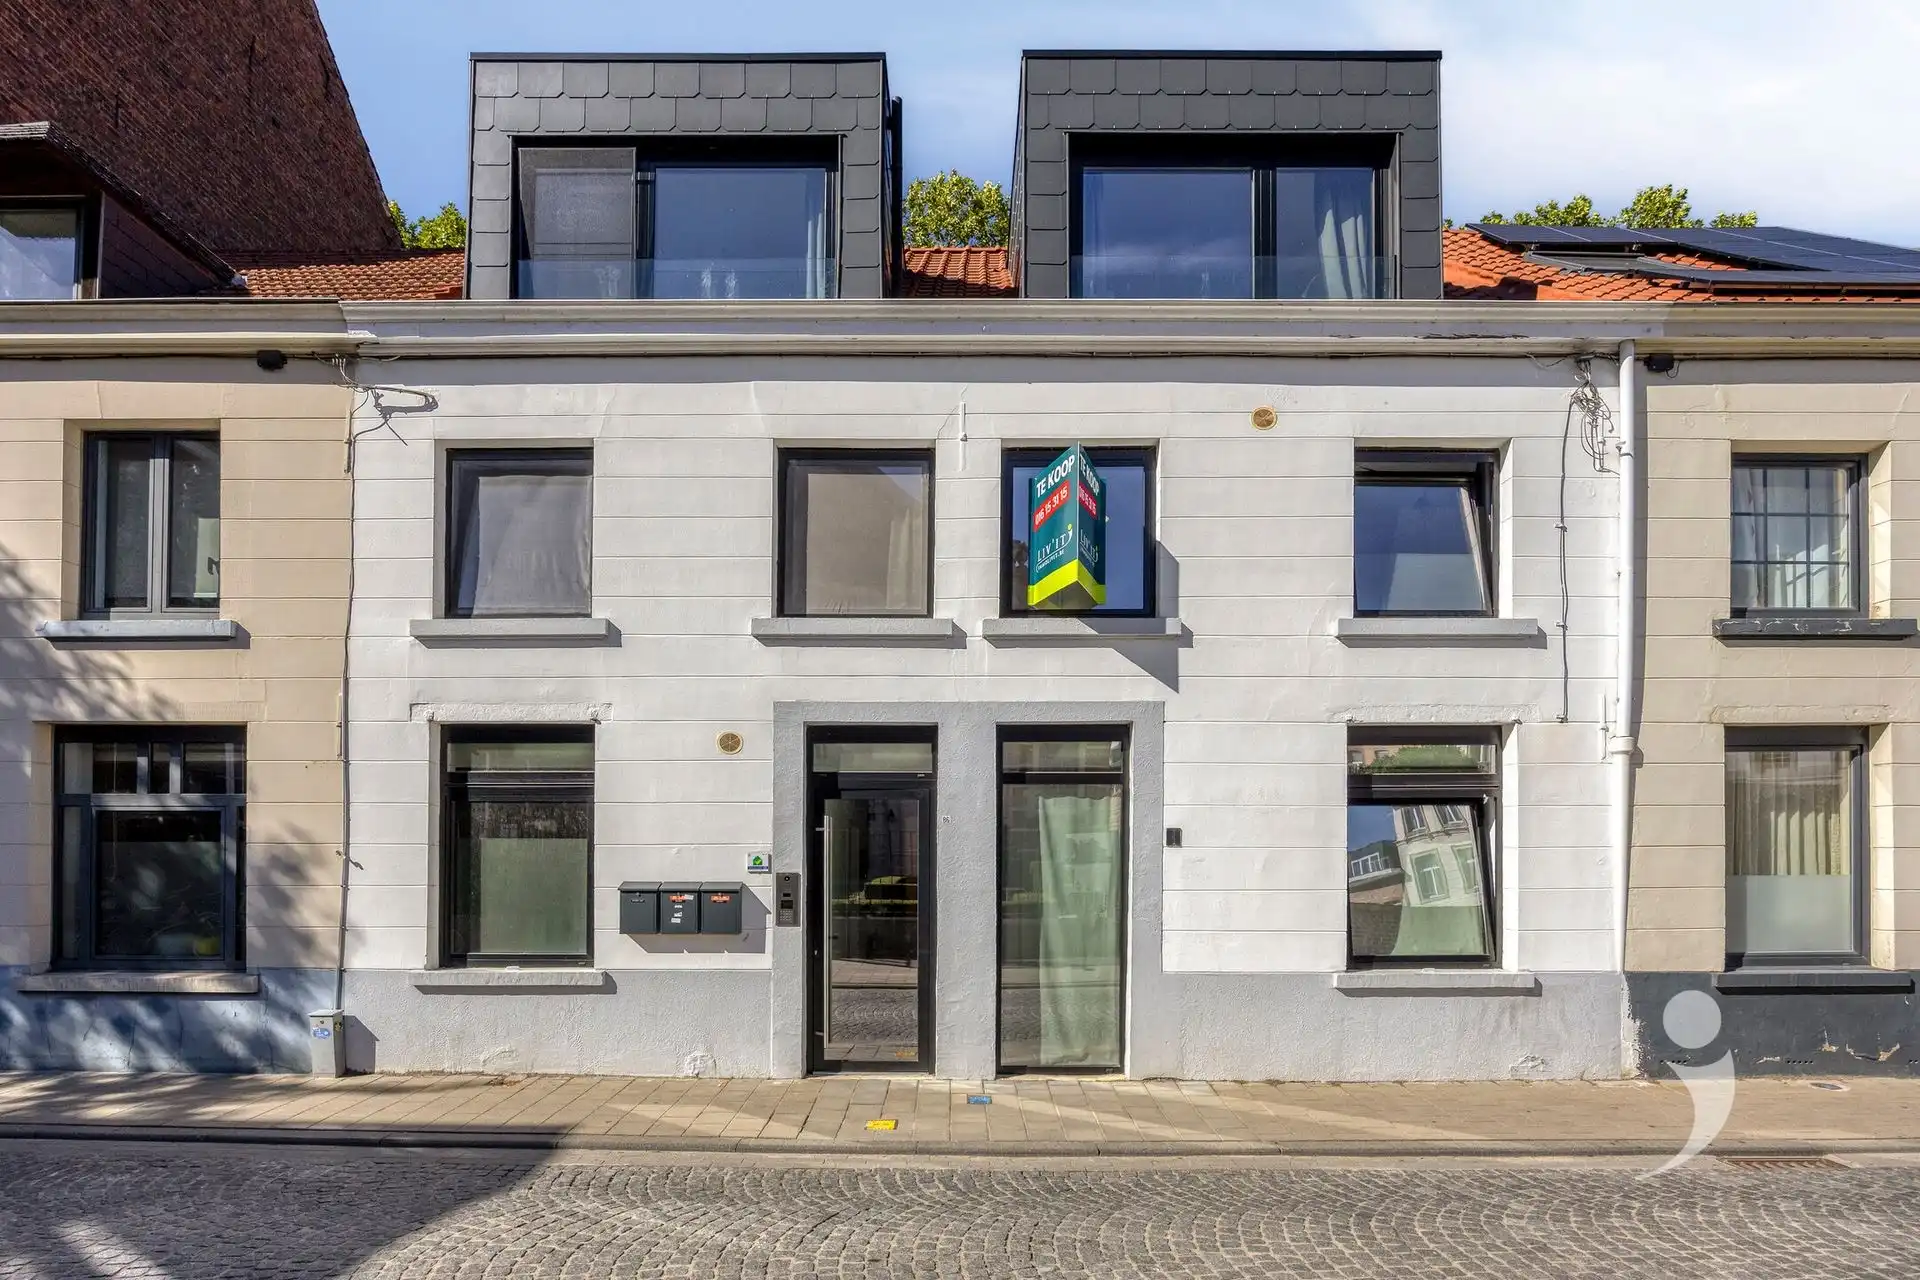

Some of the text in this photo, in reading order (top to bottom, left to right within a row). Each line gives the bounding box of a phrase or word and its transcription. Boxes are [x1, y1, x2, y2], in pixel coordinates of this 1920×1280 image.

[1036, 454, 1075, 498] TE KOOP
[1079, 452, 1100, 497] TE KOOP
[1044, 500, 1052, 516] 15
[1060, 485, 1068, 501] 15
